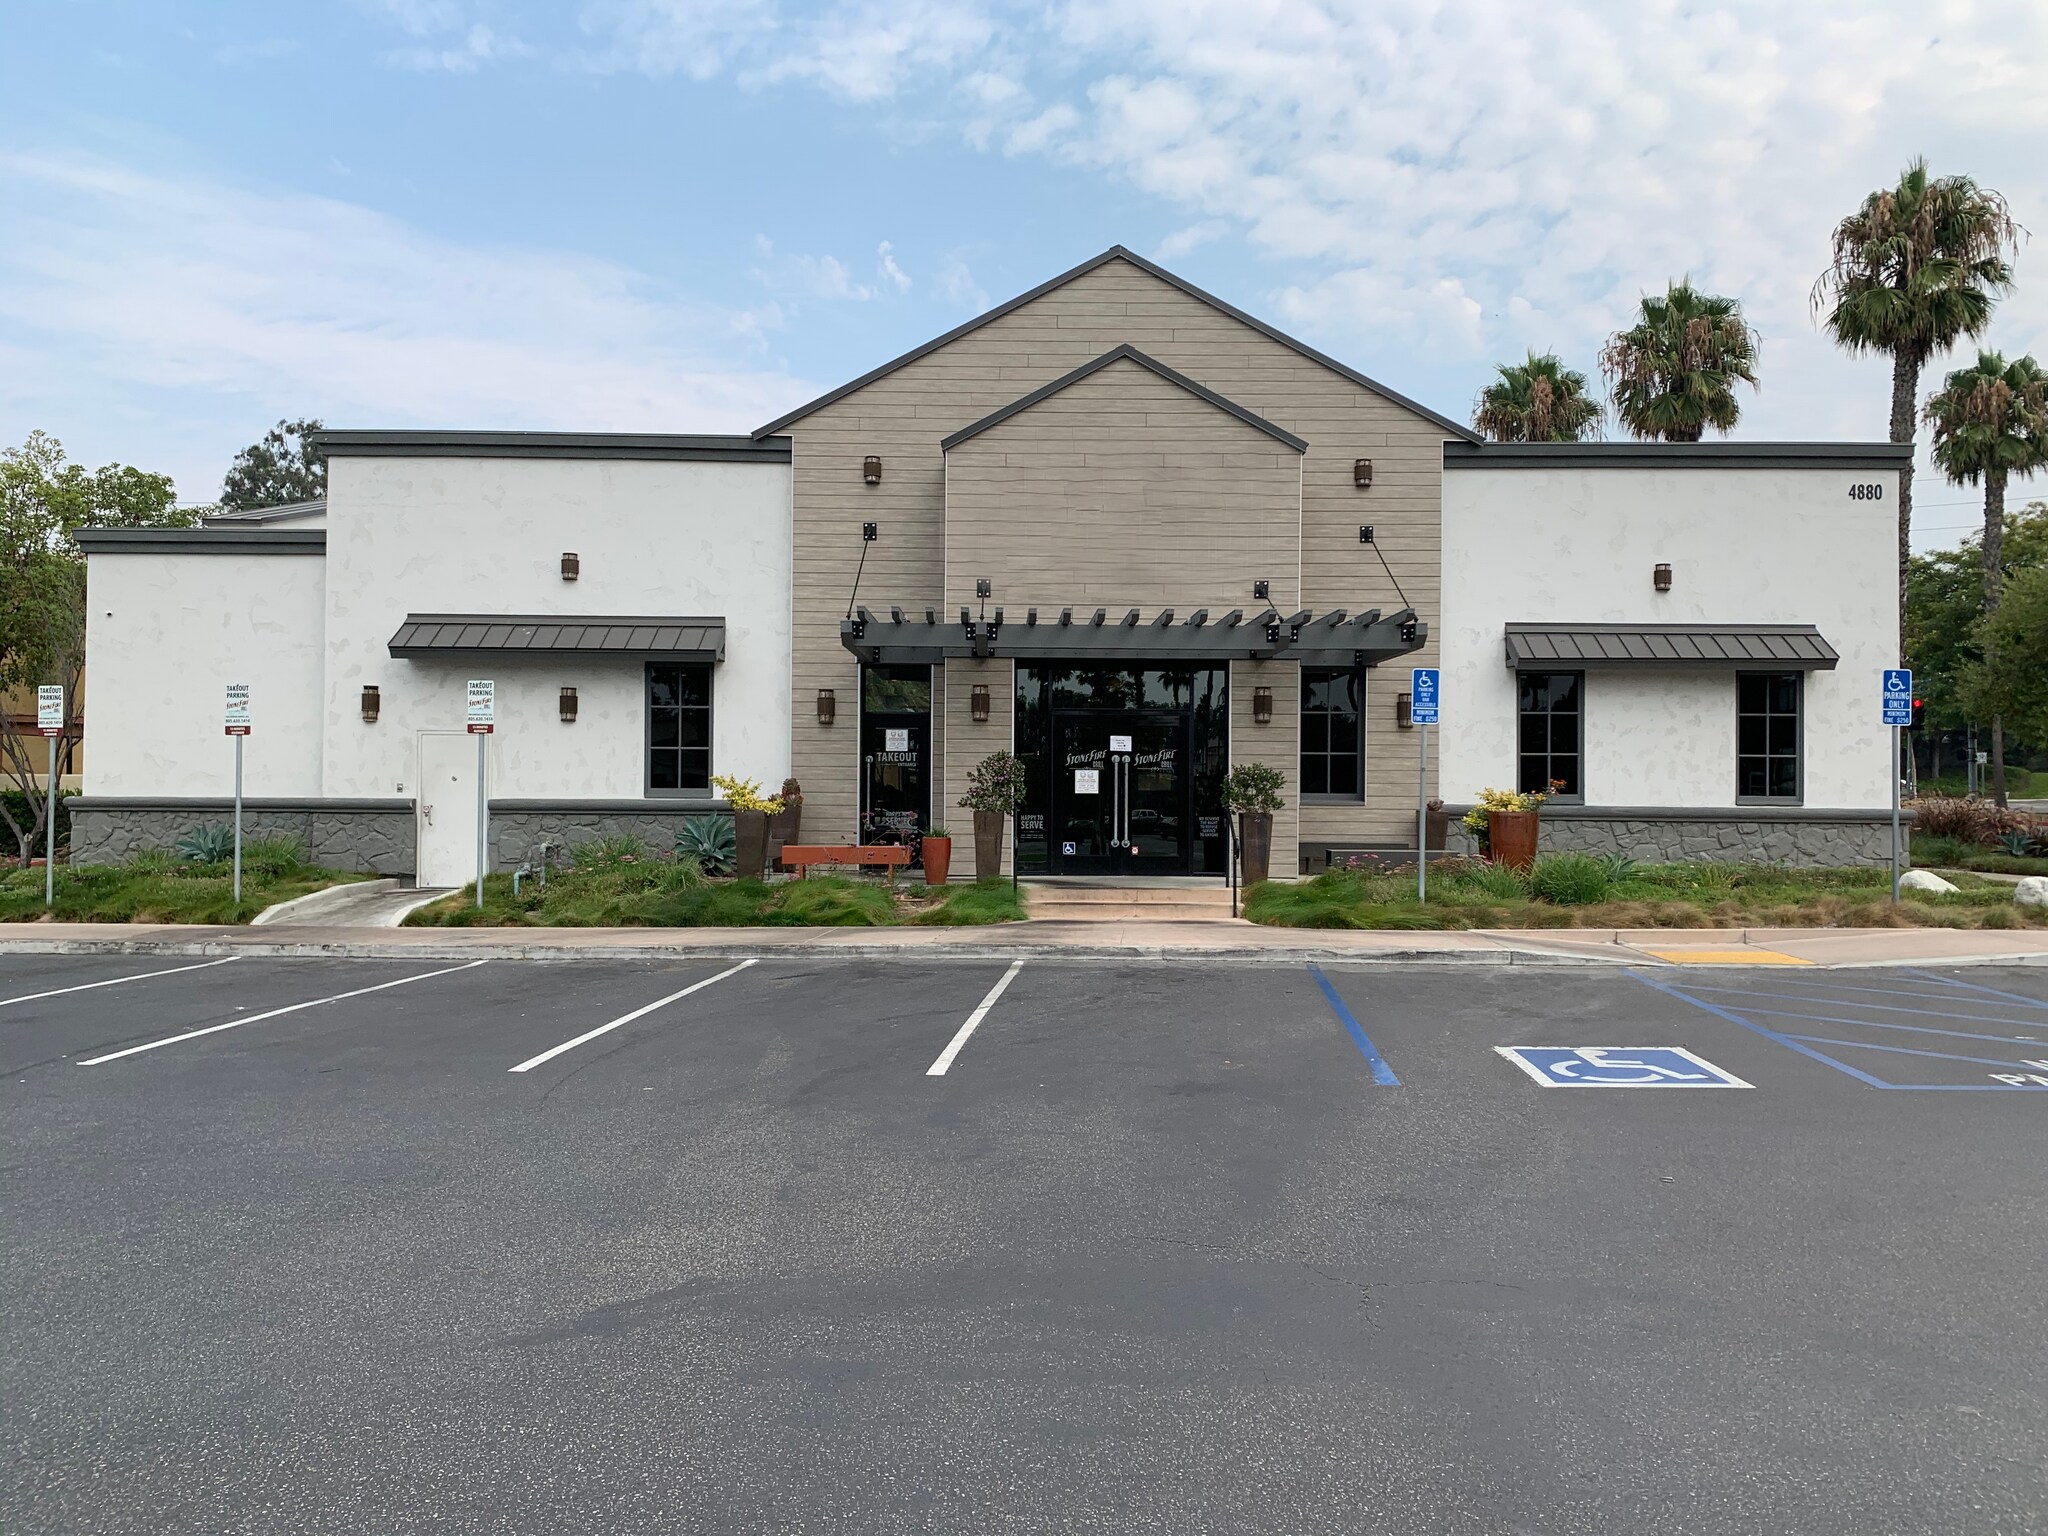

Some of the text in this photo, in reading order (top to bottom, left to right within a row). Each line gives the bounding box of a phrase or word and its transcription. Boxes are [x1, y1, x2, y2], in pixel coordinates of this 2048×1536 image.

[1848, 484, 1882, 500] 4880
[1884, 692, 1910, 700] PARKING
[1889, 700, 1905, 708] ONLY
[876, 752, 917, 762] TAKEOUT
[1020, 821, 1044, 829] SERVE
